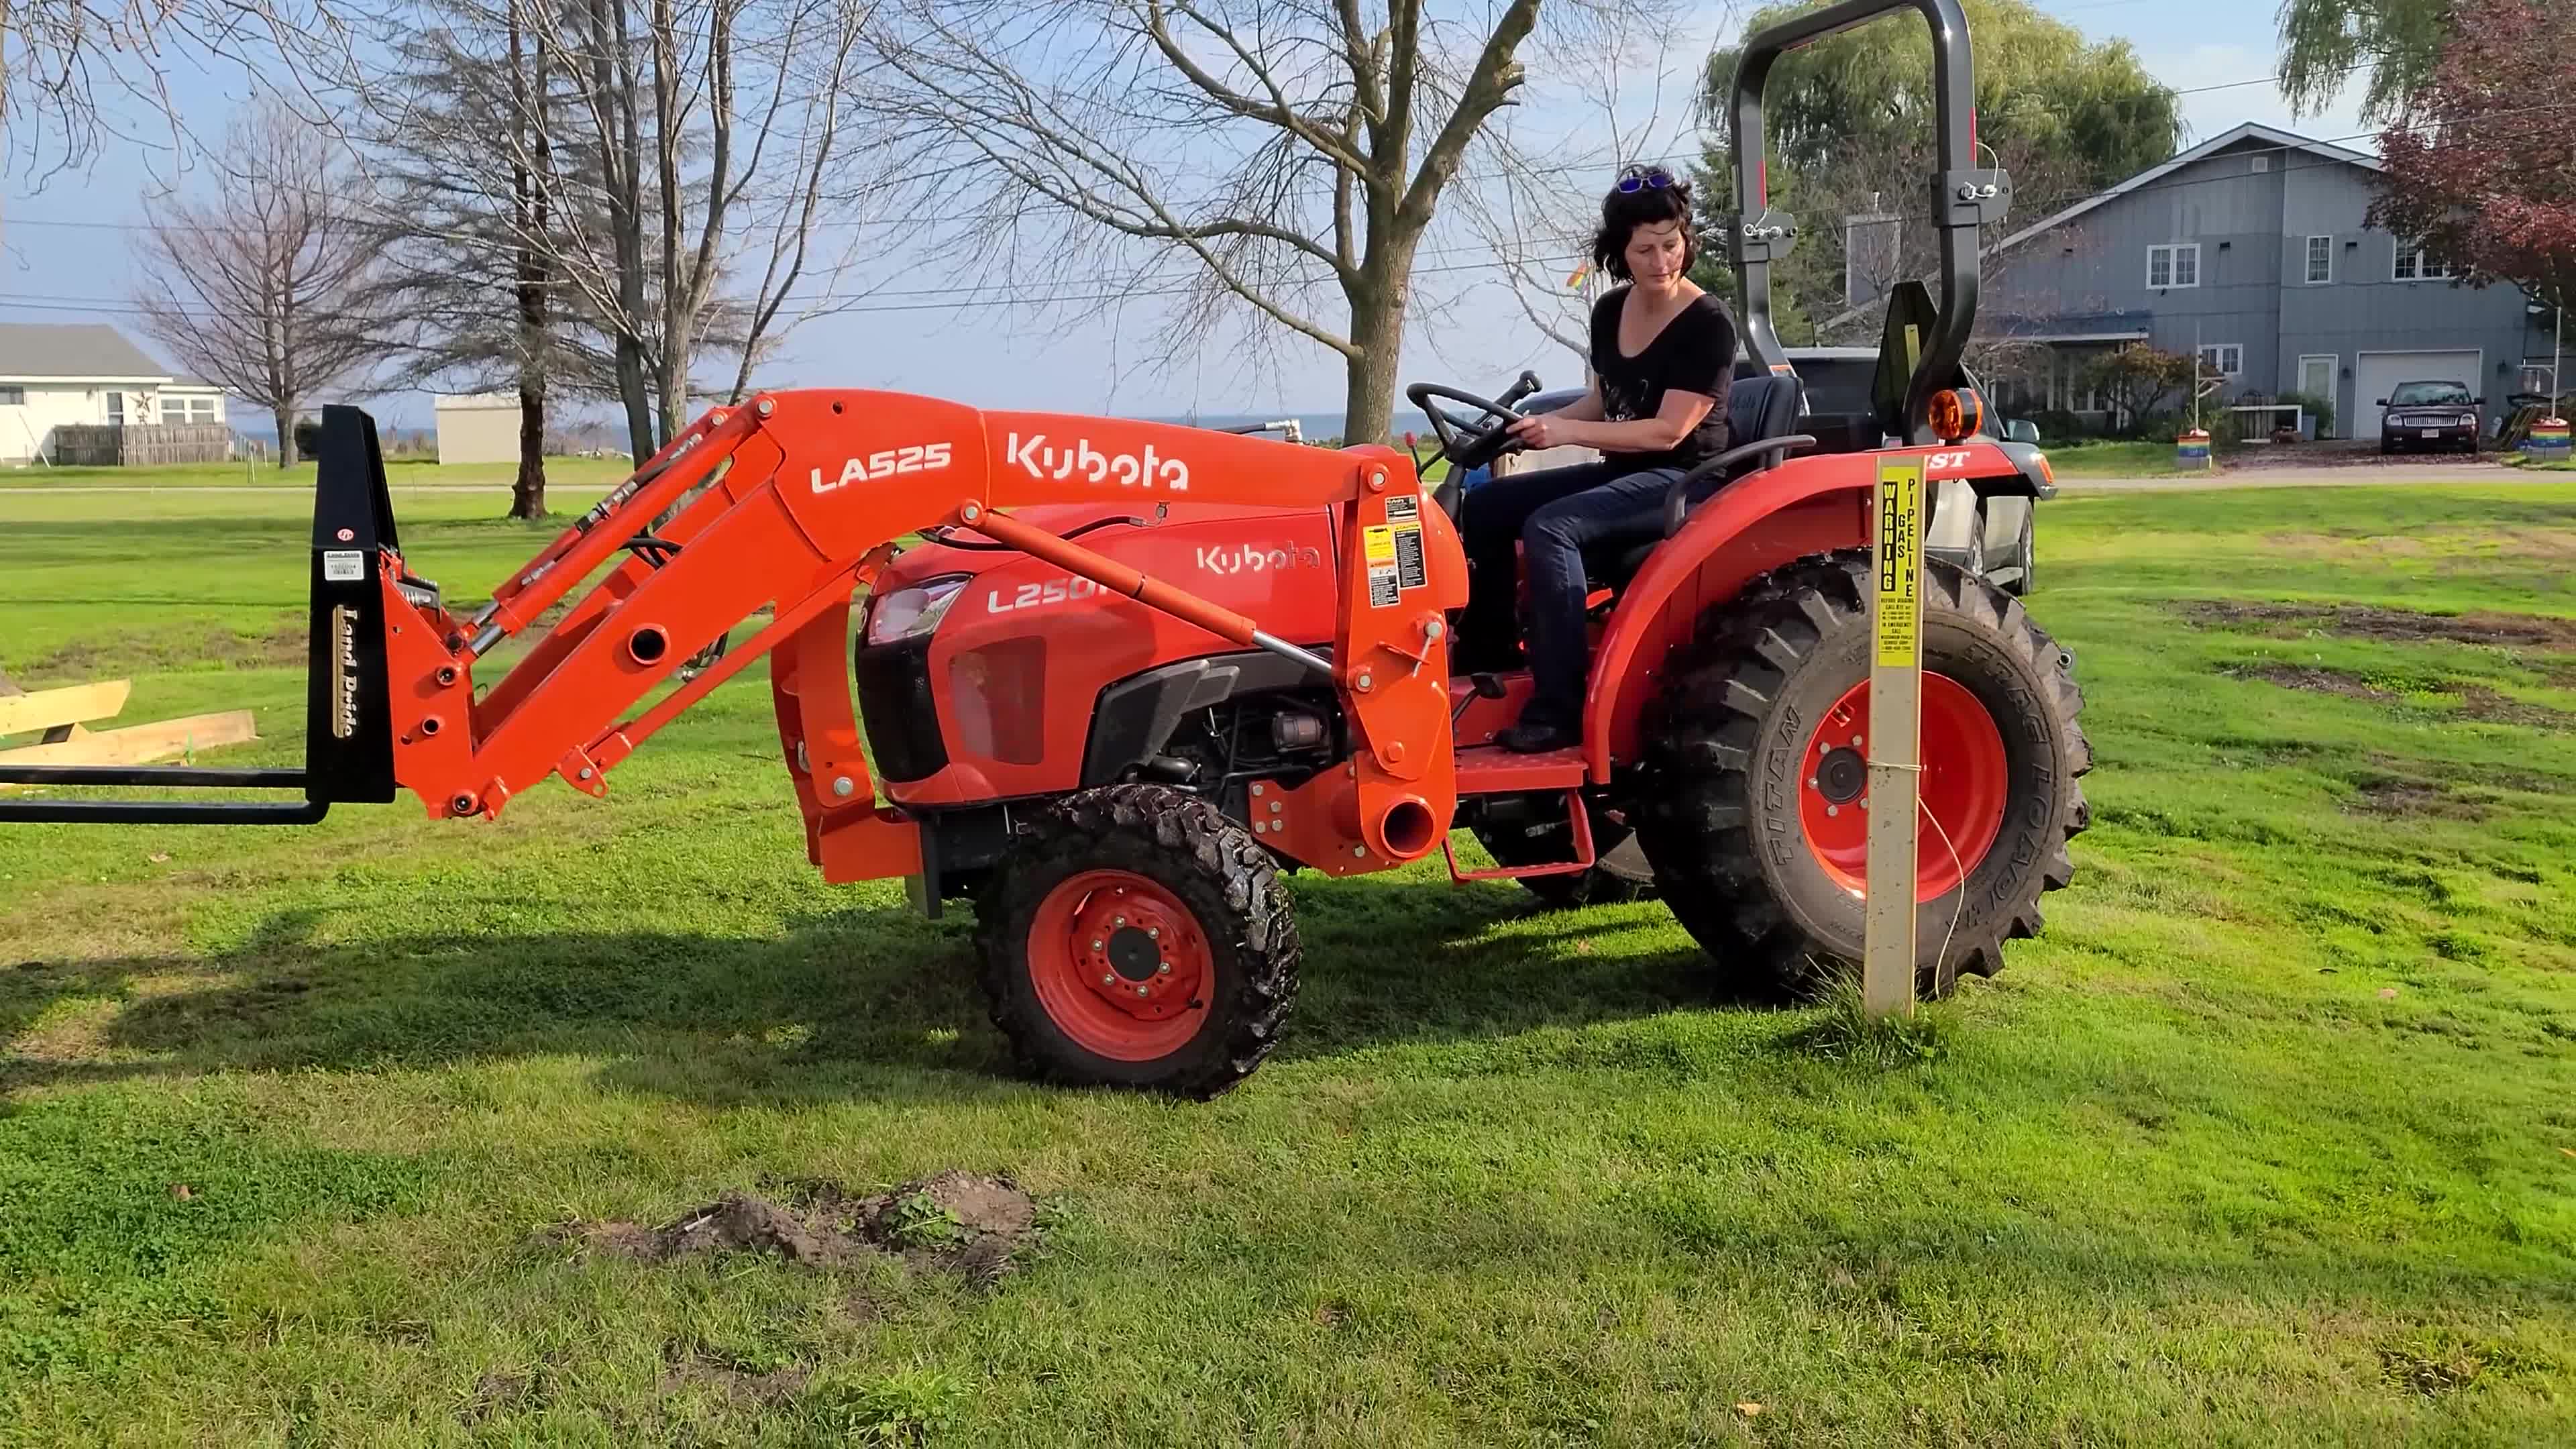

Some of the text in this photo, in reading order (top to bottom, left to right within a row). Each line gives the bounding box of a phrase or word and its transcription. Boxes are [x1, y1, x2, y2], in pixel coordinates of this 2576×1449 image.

[810, 442, 952, 494] LA525
[1007, 432, 1189, 490] Kubota
[1925, 451, 1971, 469] ST
[1197, 540, 1321, 575] Kubota
[1883, 484, 1896, 590] WARNING
[1897, 514, 1906, 558] GAS
[1905, 478, 1915, 597] PIPELINE
[342, 608, 358, 737] Land Pride
[1765, 704, 1801, 865] TITAN
